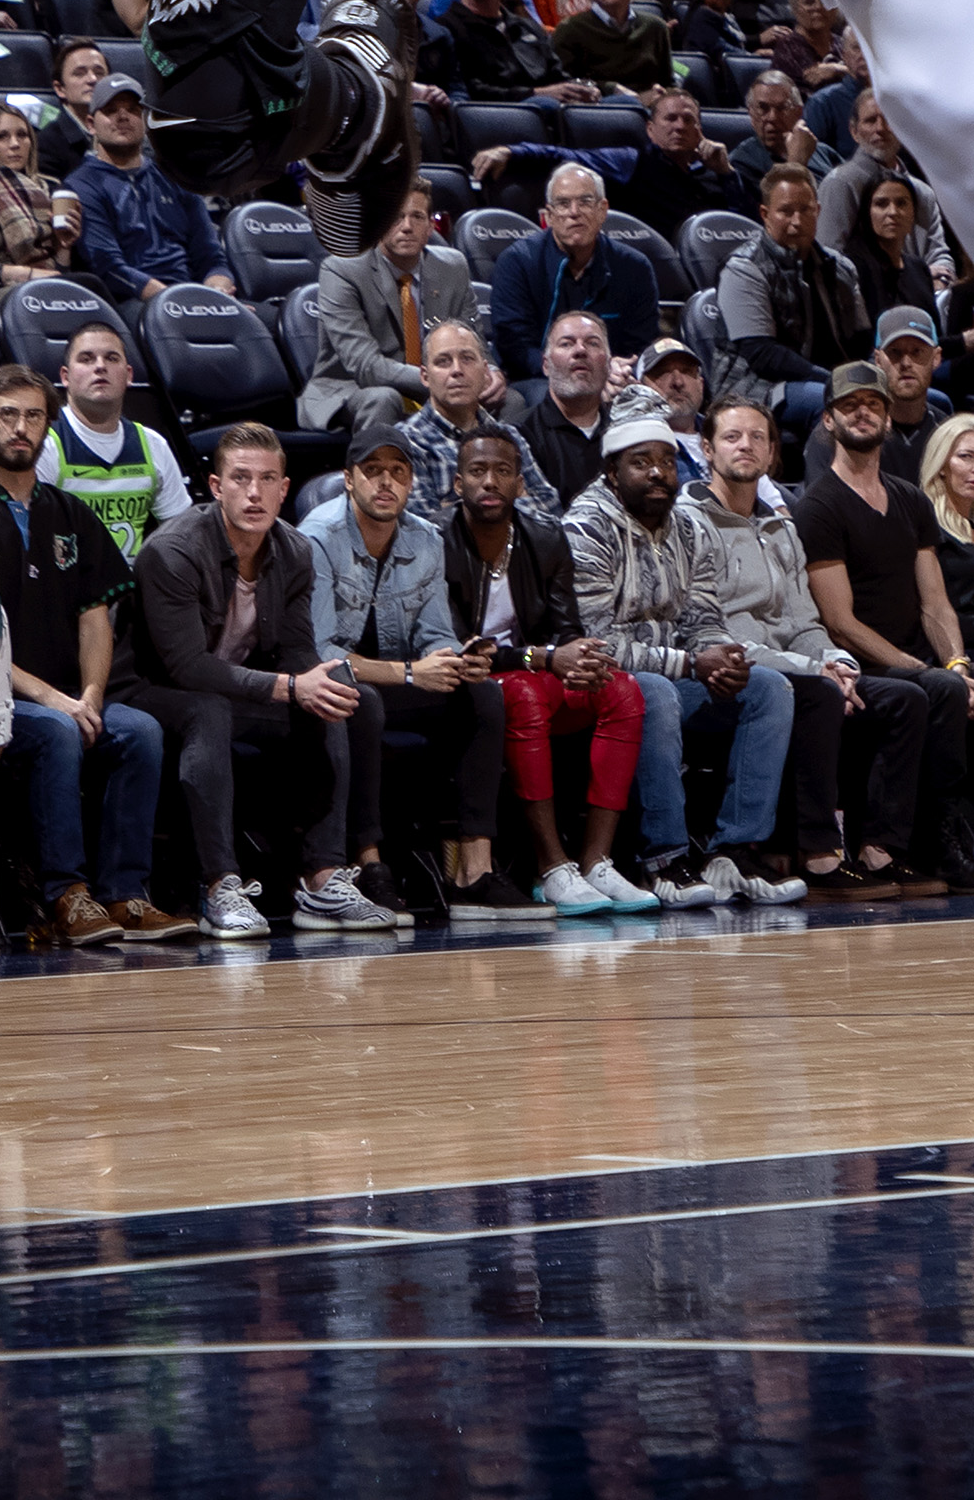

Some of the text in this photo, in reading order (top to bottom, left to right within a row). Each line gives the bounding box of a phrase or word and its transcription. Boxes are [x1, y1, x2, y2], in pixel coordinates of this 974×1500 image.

[260, 221, 313, 234] LEXUS
[39, 299, 100, 312] LEXUS
[181, 304, 240, 316] LEXUS
